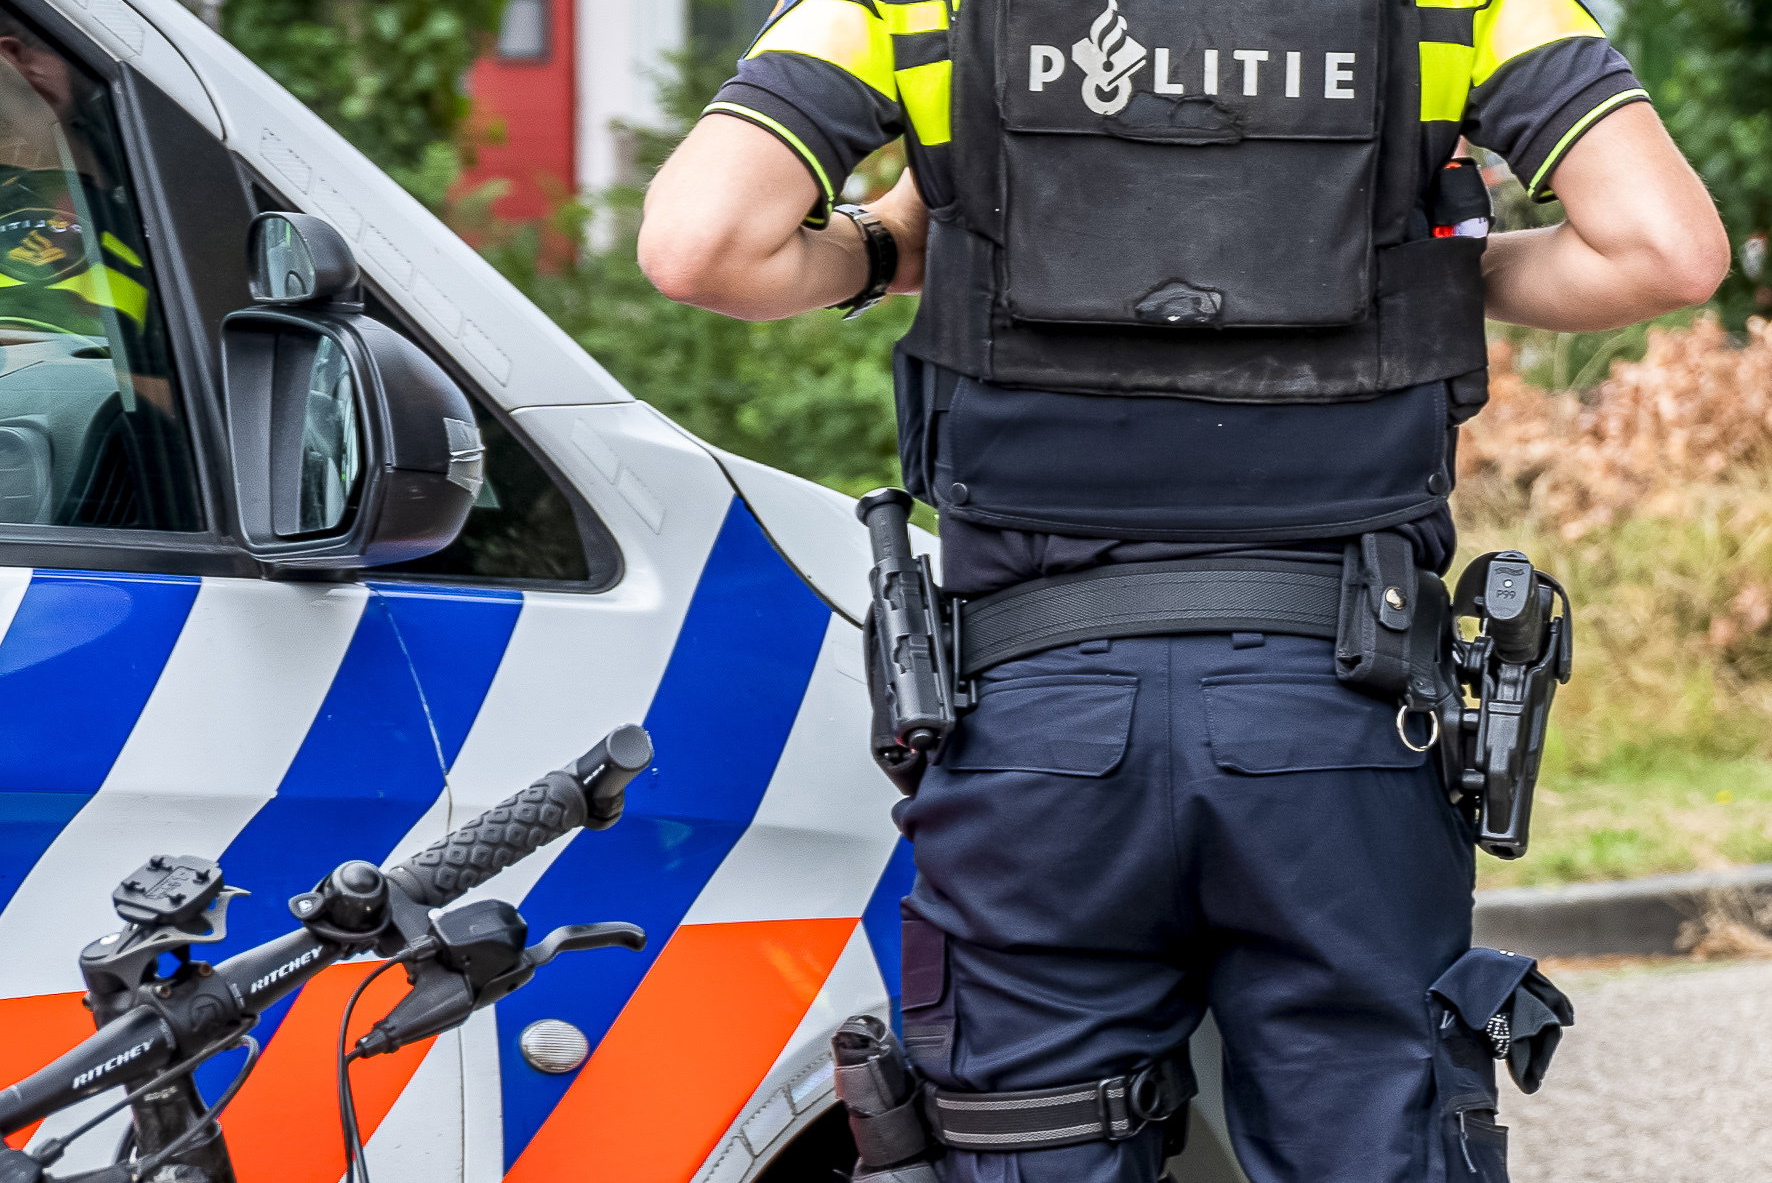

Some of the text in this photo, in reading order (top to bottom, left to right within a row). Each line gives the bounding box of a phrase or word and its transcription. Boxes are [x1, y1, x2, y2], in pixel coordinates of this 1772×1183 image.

[1028, 36, 1355, 116] POLITIE
[250, 945, 324, 994] RITCHEY
[72, 1039, 155, 1090] RITCHEY
